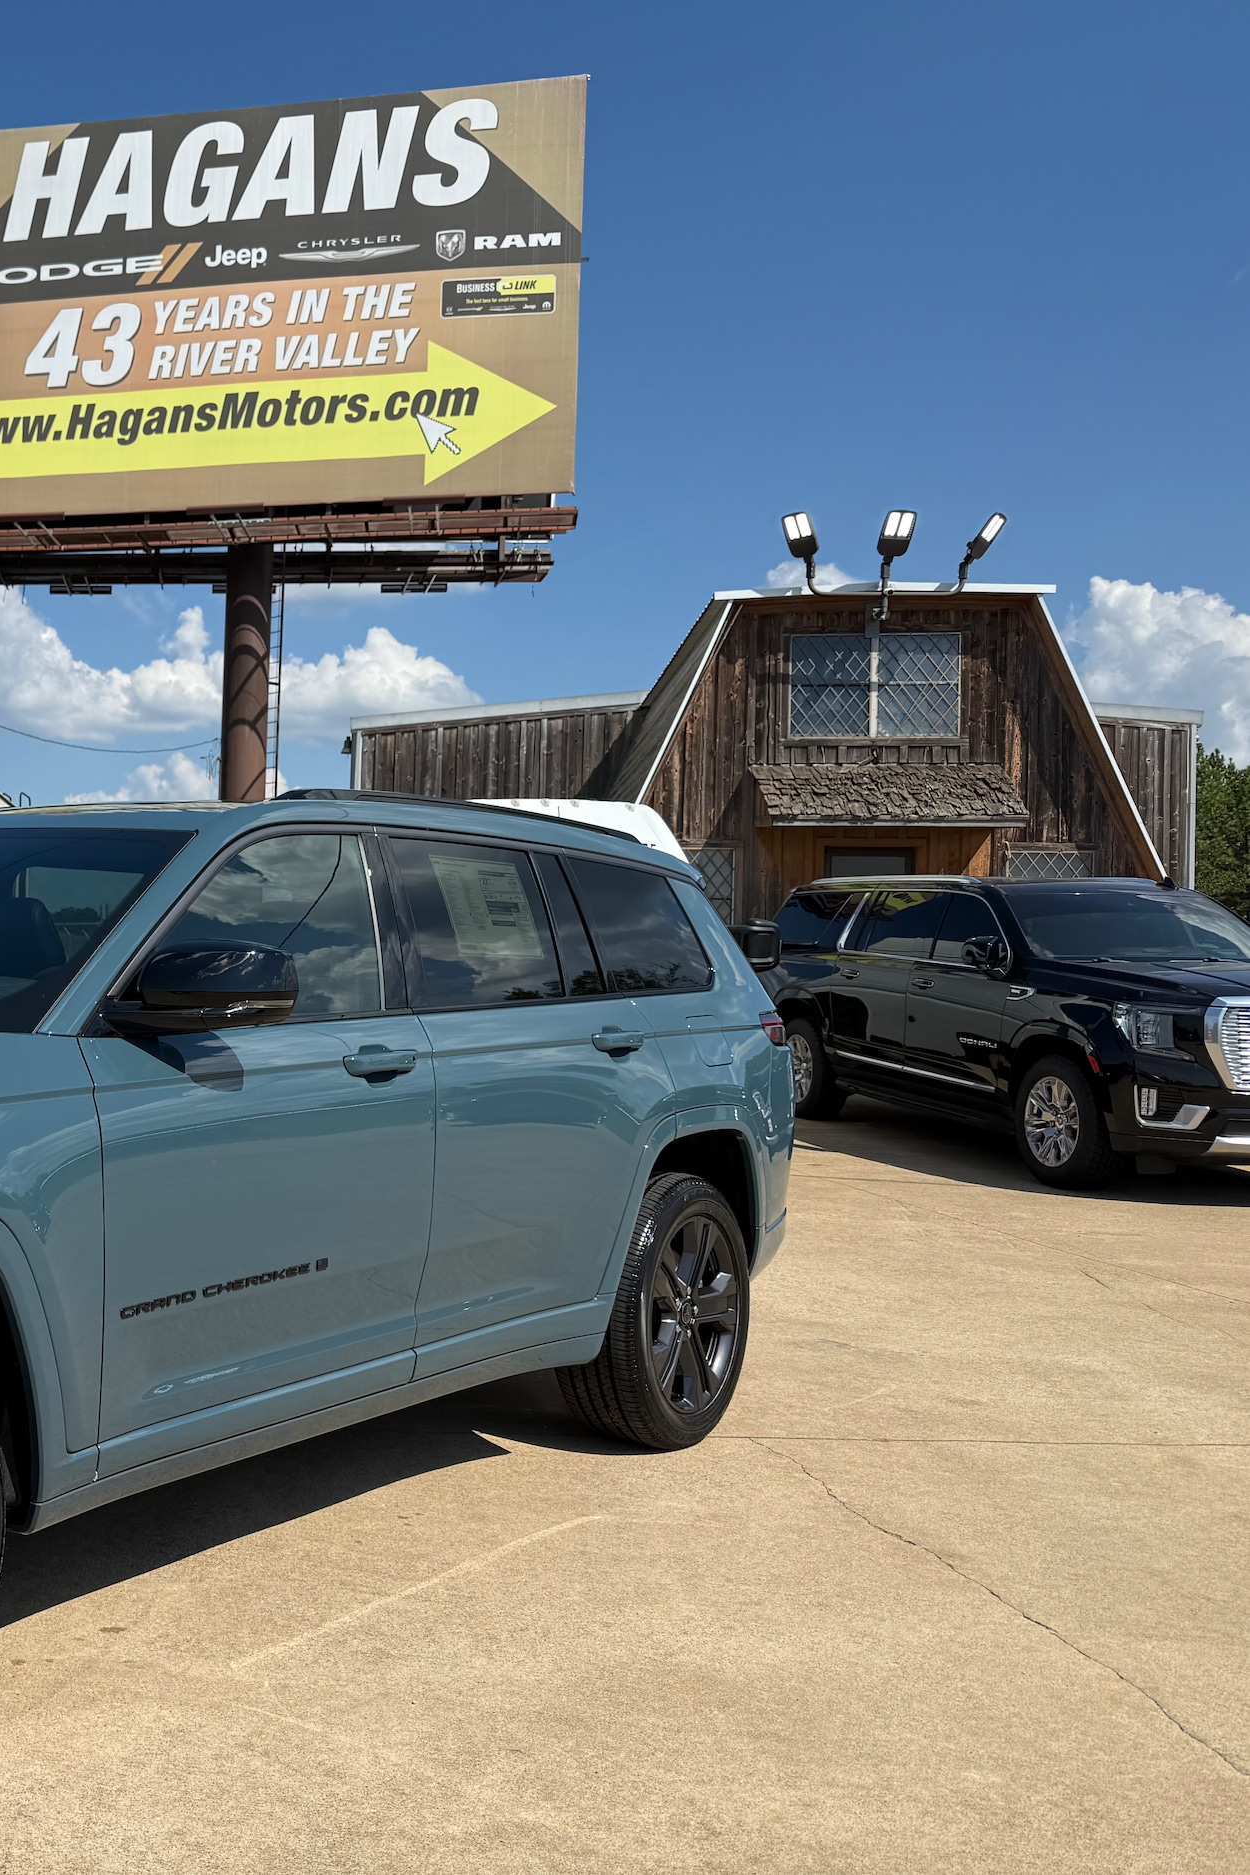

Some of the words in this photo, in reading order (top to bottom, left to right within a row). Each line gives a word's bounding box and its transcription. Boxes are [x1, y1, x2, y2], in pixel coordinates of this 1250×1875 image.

[3, 98, 499, 242] HAGANS
[205, 244, 267, 269] Jeep
[297, 234, 402, 249] CHRYSLER
[474, 232, 561, 250] RAM
[153, 288, 274, 335] YEARS
[286, 286, 336, 325] IN
[341, 282, 417, 321] THE
[514, 280, 537, 290] LINK
[23, 302, 142, 389] 43
[148, 337, 261, 380] RIVER
[274, 327, 420, 371] VALLEY
[120, 1289, 197, 1320] GRAND
[202, 1262, 312, 1299] CHEROKEE
